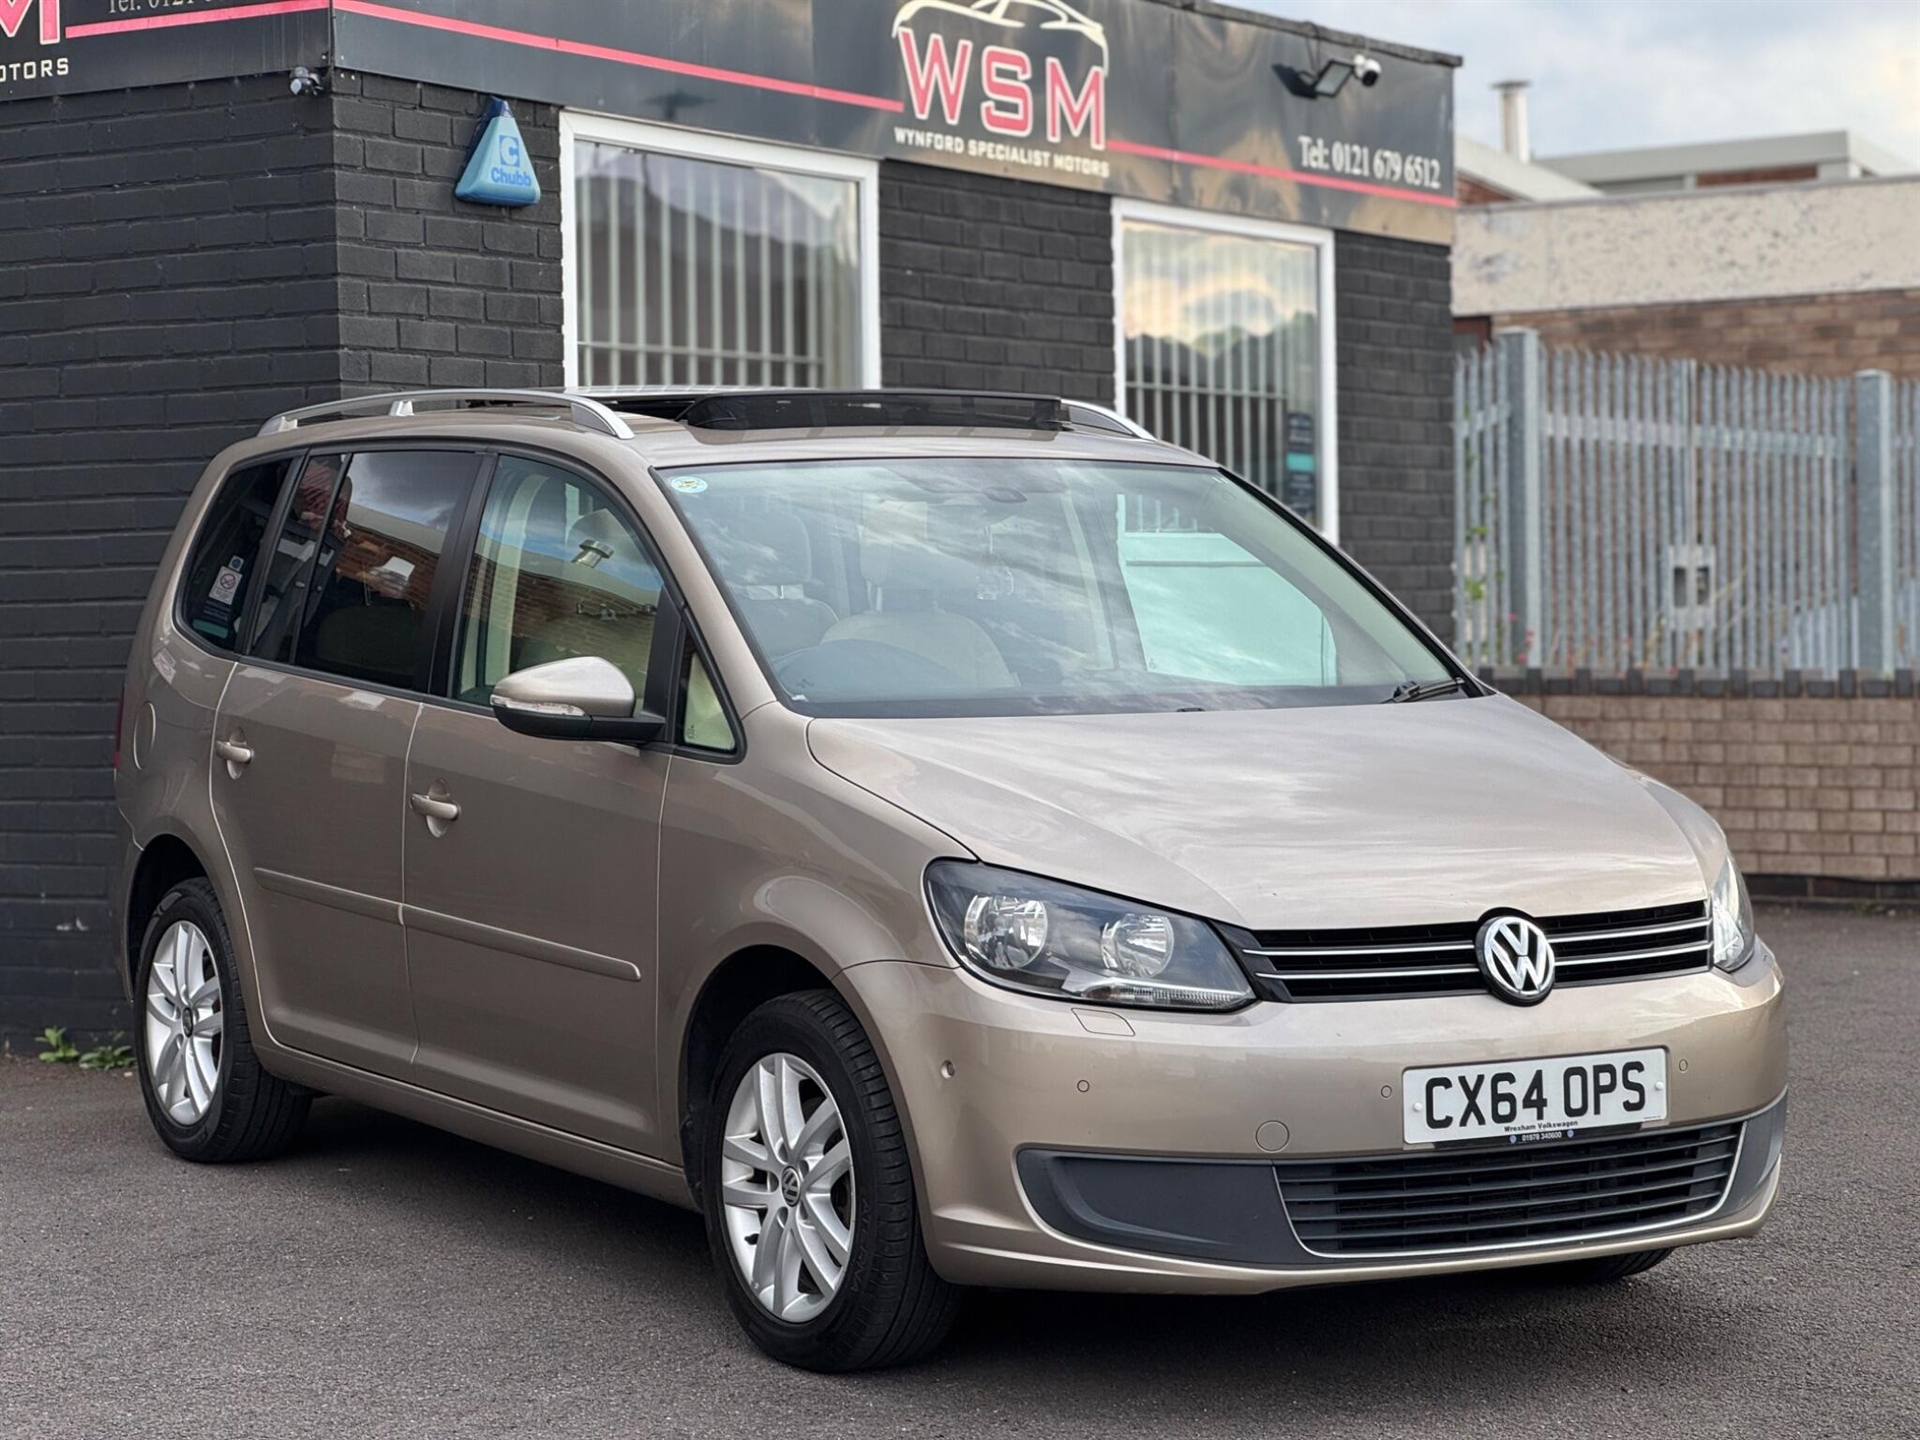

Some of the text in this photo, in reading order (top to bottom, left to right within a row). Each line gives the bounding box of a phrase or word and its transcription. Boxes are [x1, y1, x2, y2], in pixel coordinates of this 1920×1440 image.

[898, 26, 1105, 150] WSM
[491, 167, 532, 187] Chubb
[893, 126, 1110, 178] WYNFORD SPECIALIST MOTORS
[1298, 135, 1441, 189] Tel: 0121 679 6512
[1425, 1061, 1646, 1129] CX64 OPS
[1504, 1121, 1578, 1133] Wrexham Volkswagen
